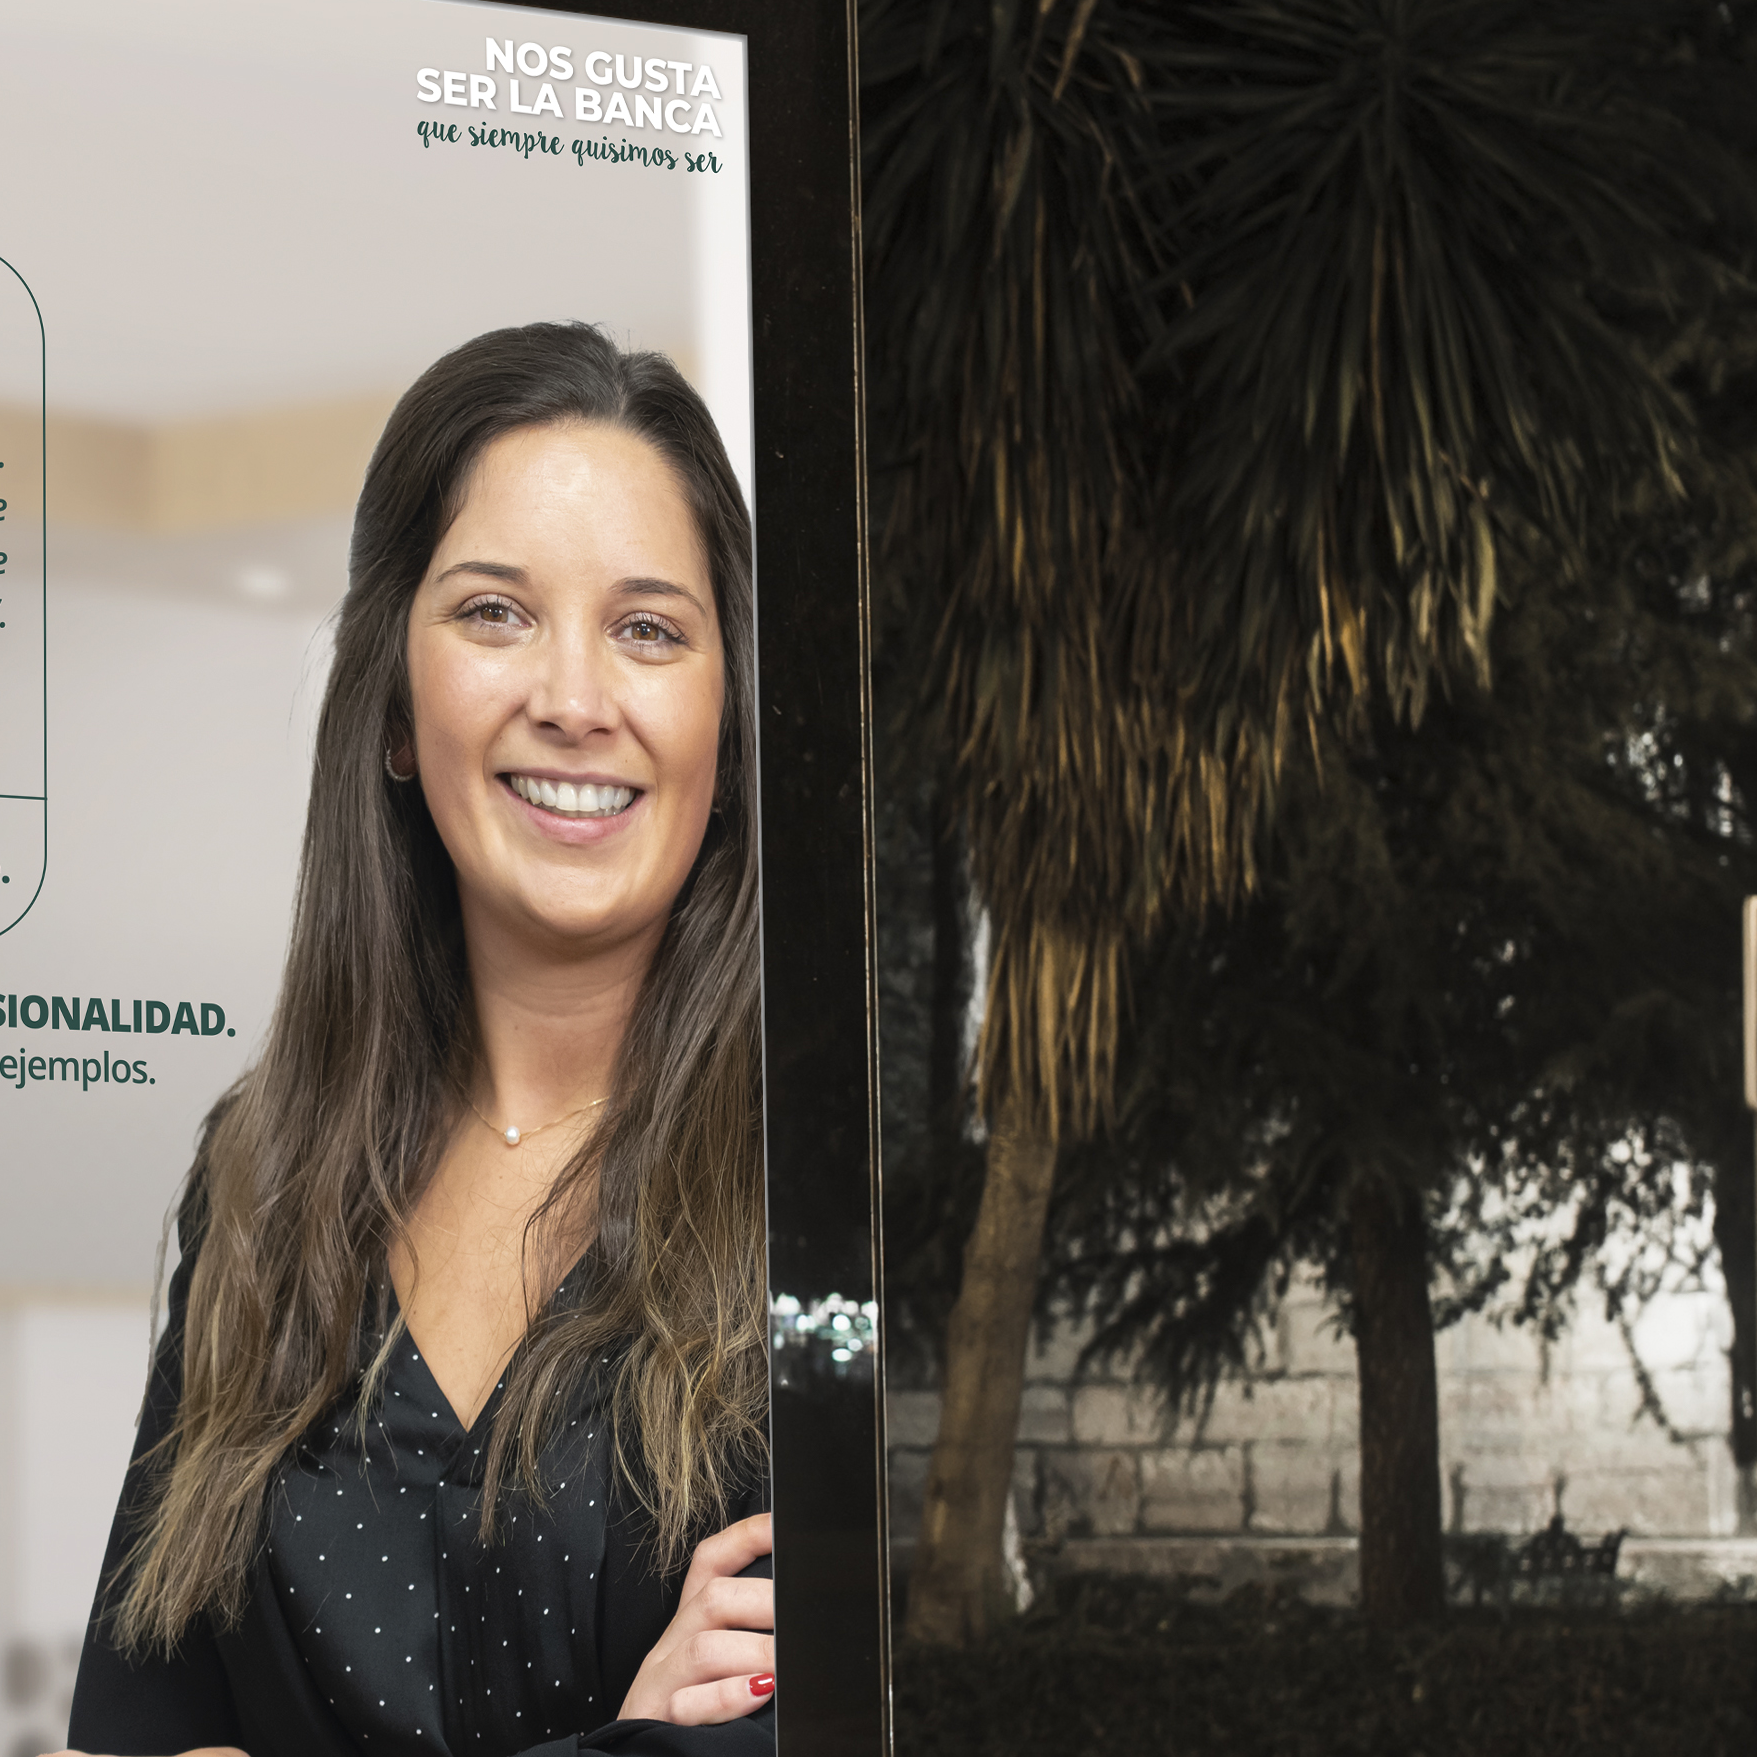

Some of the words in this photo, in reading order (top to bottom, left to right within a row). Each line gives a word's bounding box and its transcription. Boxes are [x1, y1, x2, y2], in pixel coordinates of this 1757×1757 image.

[485, 38, 574, 80] NOS
[585, 50, 722, 100] GUSTA
[416, 67, 497, 110] SER
[509, 78, 564, 118] LA
[576, 85, 723, 138] BANCA
[416, 120, 463, 149] que
[468, 121, 565, 160] siempre
[571, 135, 679, 171] quisimos
[684, 151, 723, 174] ser
[0, 1047, 156, 1092] ejemplos.
